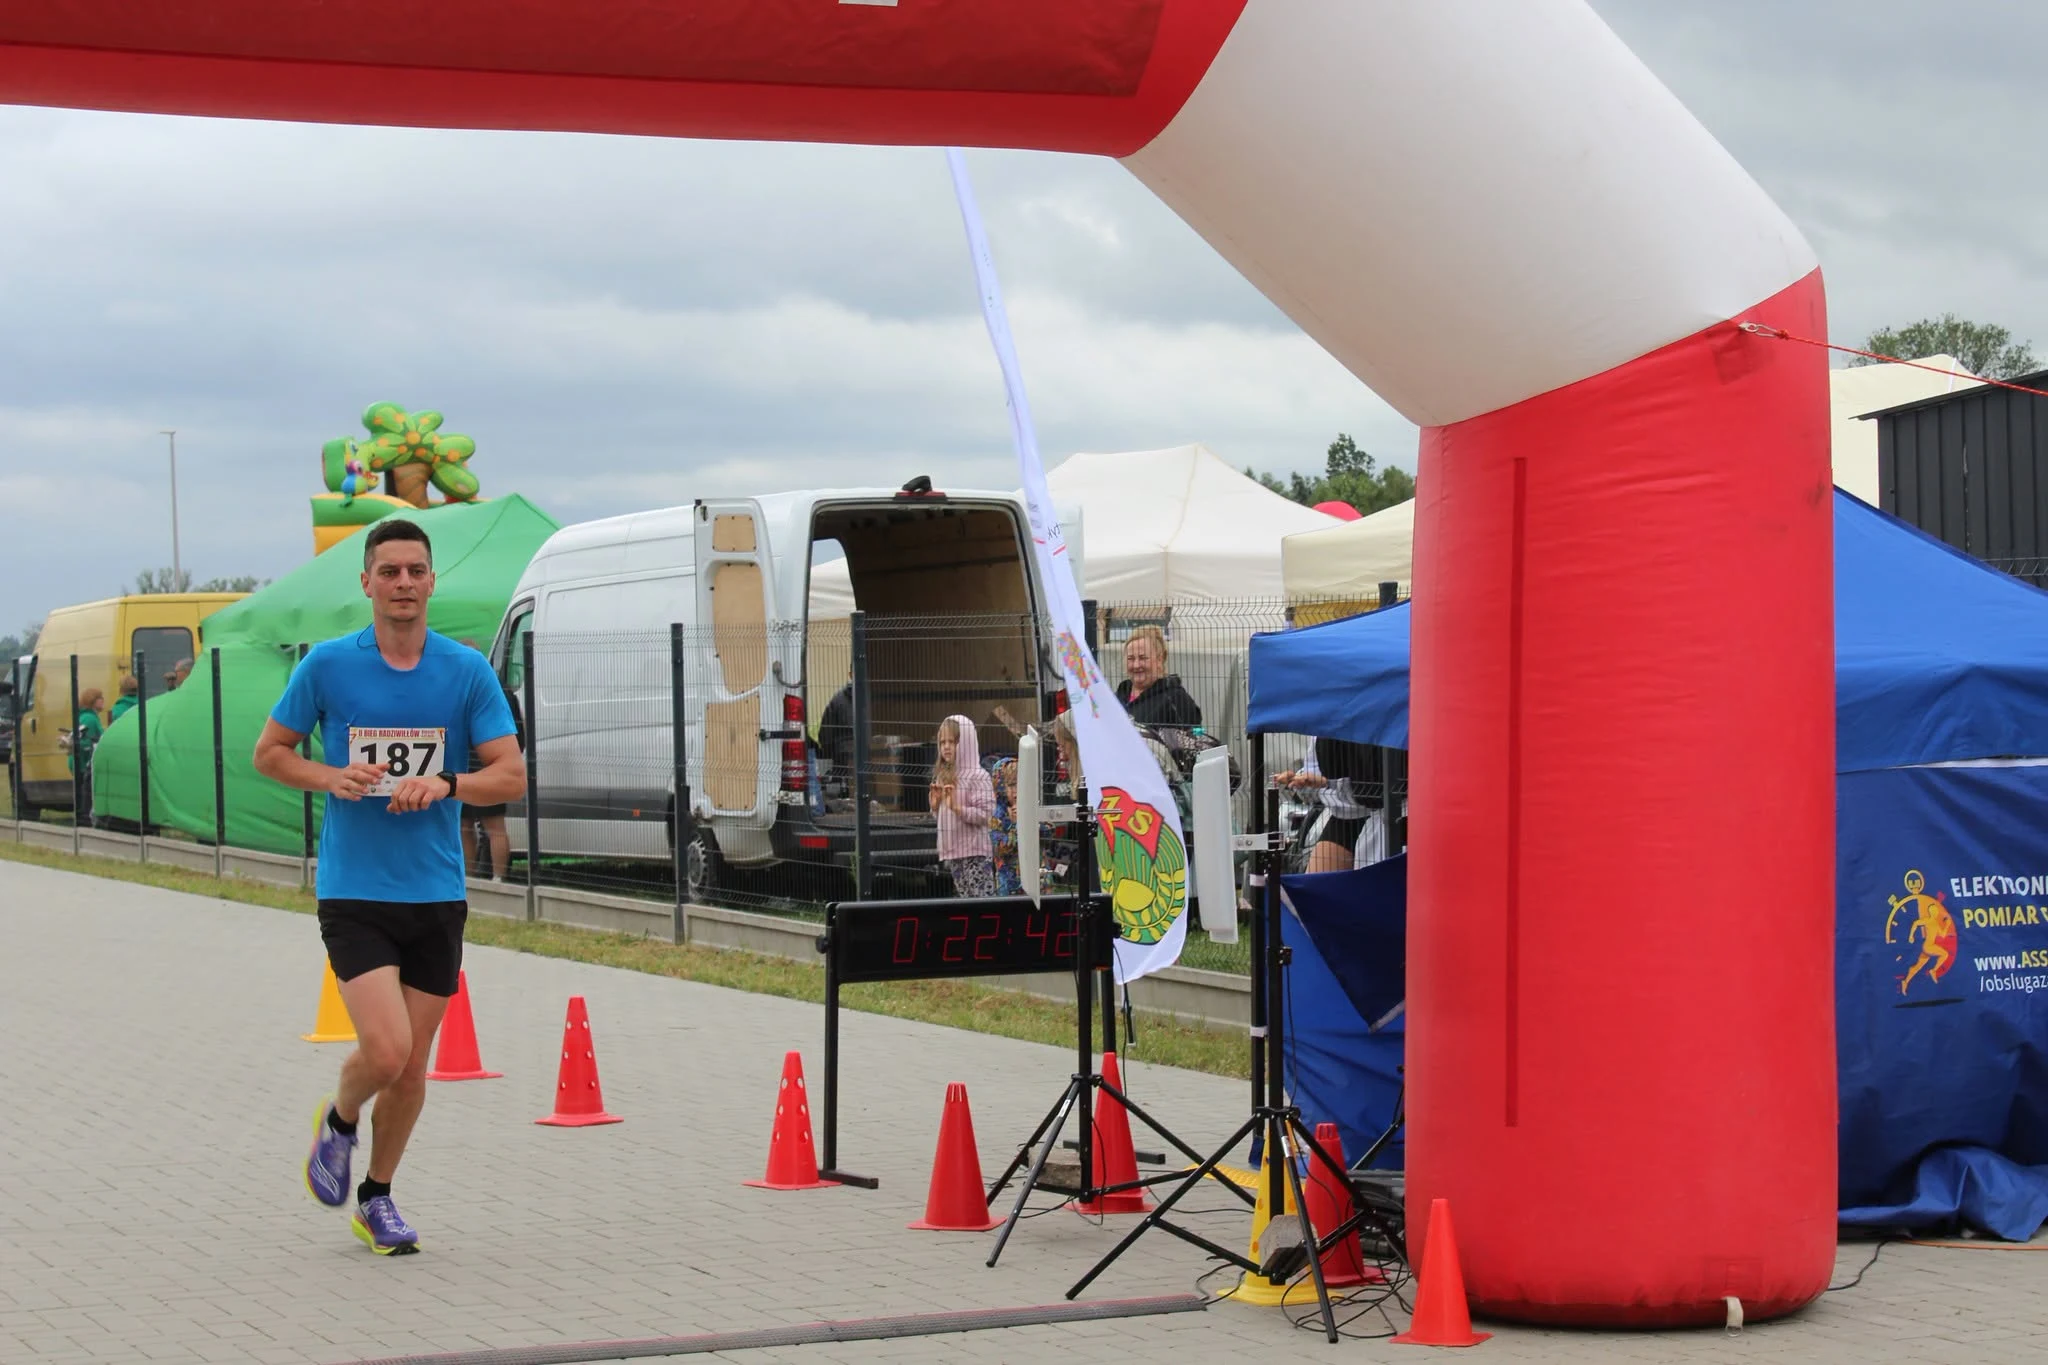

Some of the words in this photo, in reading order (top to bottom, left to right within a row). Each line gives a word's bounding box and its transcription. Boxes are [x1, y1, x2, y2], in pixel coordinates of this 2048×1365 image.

[360, 742, 437, 777] 187
[1963, 905, 2040, 928] POMIAR
[892, 913, 1079, 963] 0:22:42
[1980, 973, 2048, 993] /obslugaz
